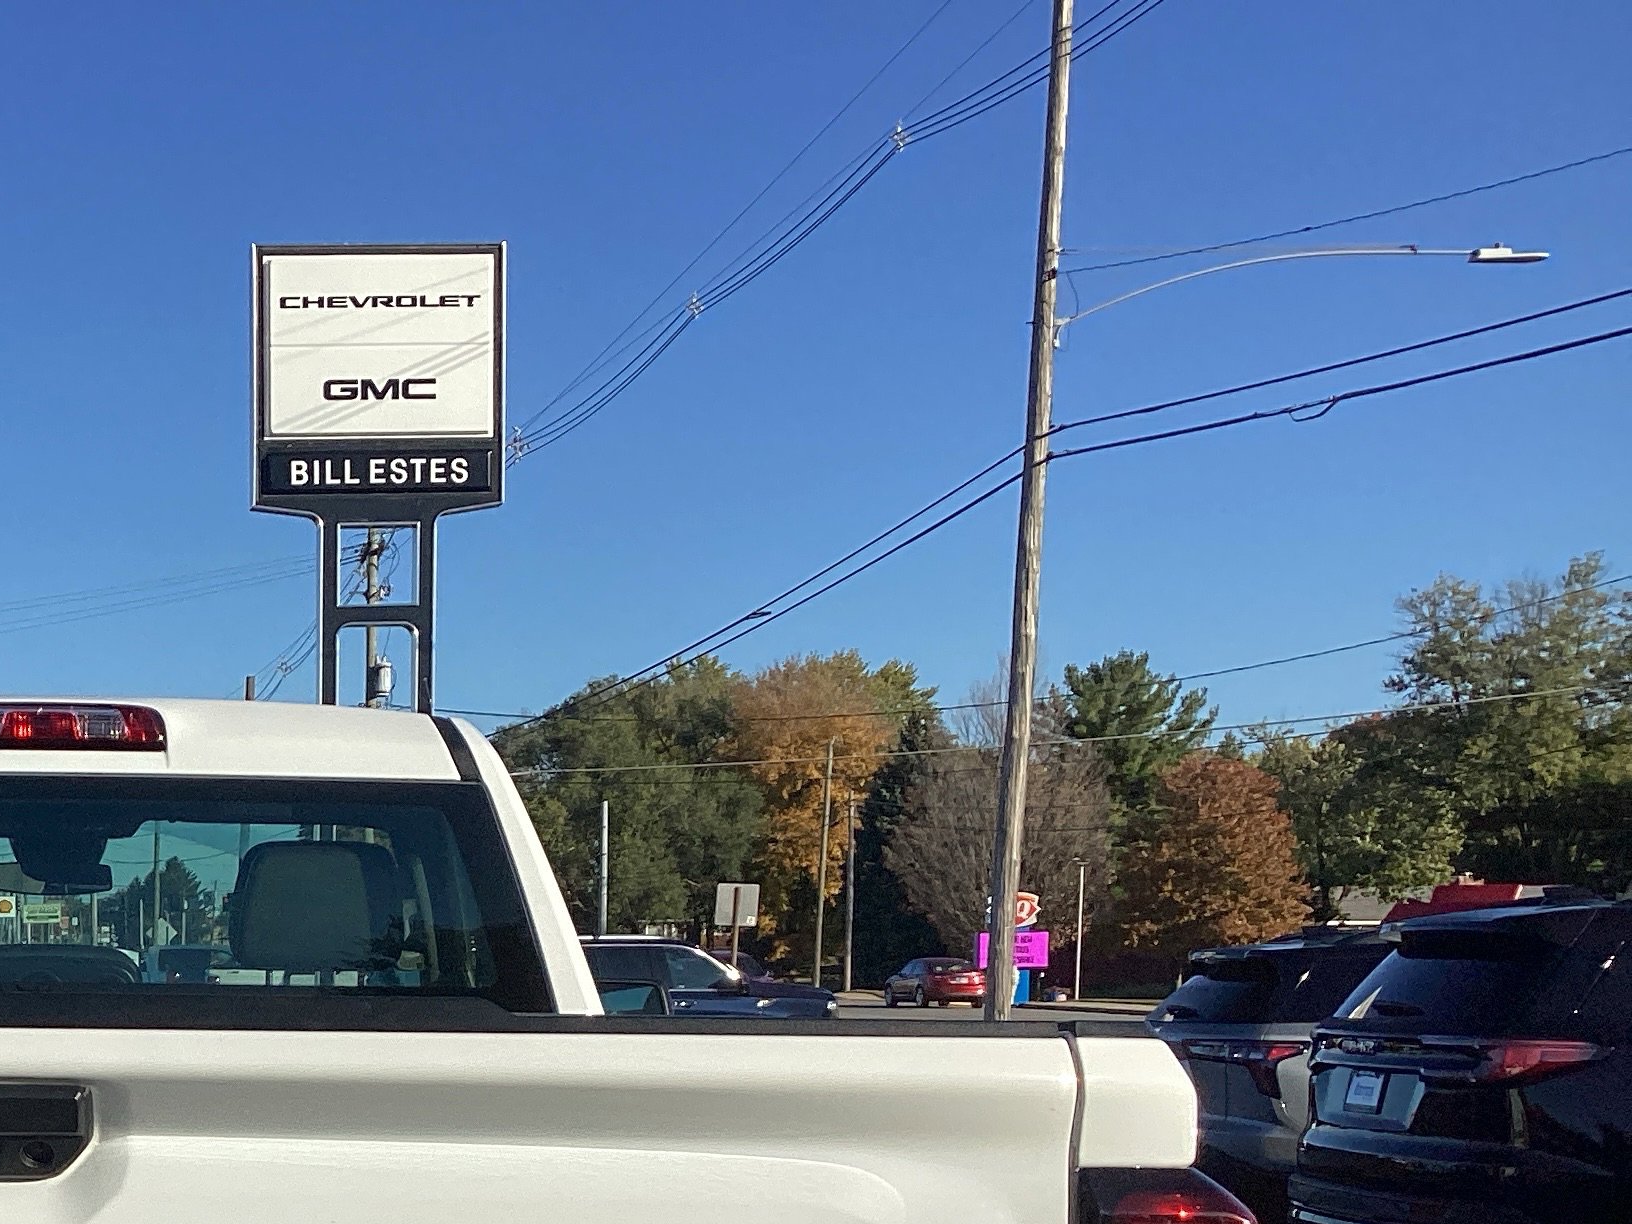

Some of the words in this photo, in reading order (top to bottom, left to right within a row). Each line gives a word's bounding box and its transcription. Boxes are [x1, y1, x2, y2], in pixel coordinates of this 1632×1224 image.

[279, 294, 481, 309] CHEVROLET
[323, 378, 437, 400] GMC
[290, 459, 360, 485] BILL
[369, 457, 469, 484] ESTES
